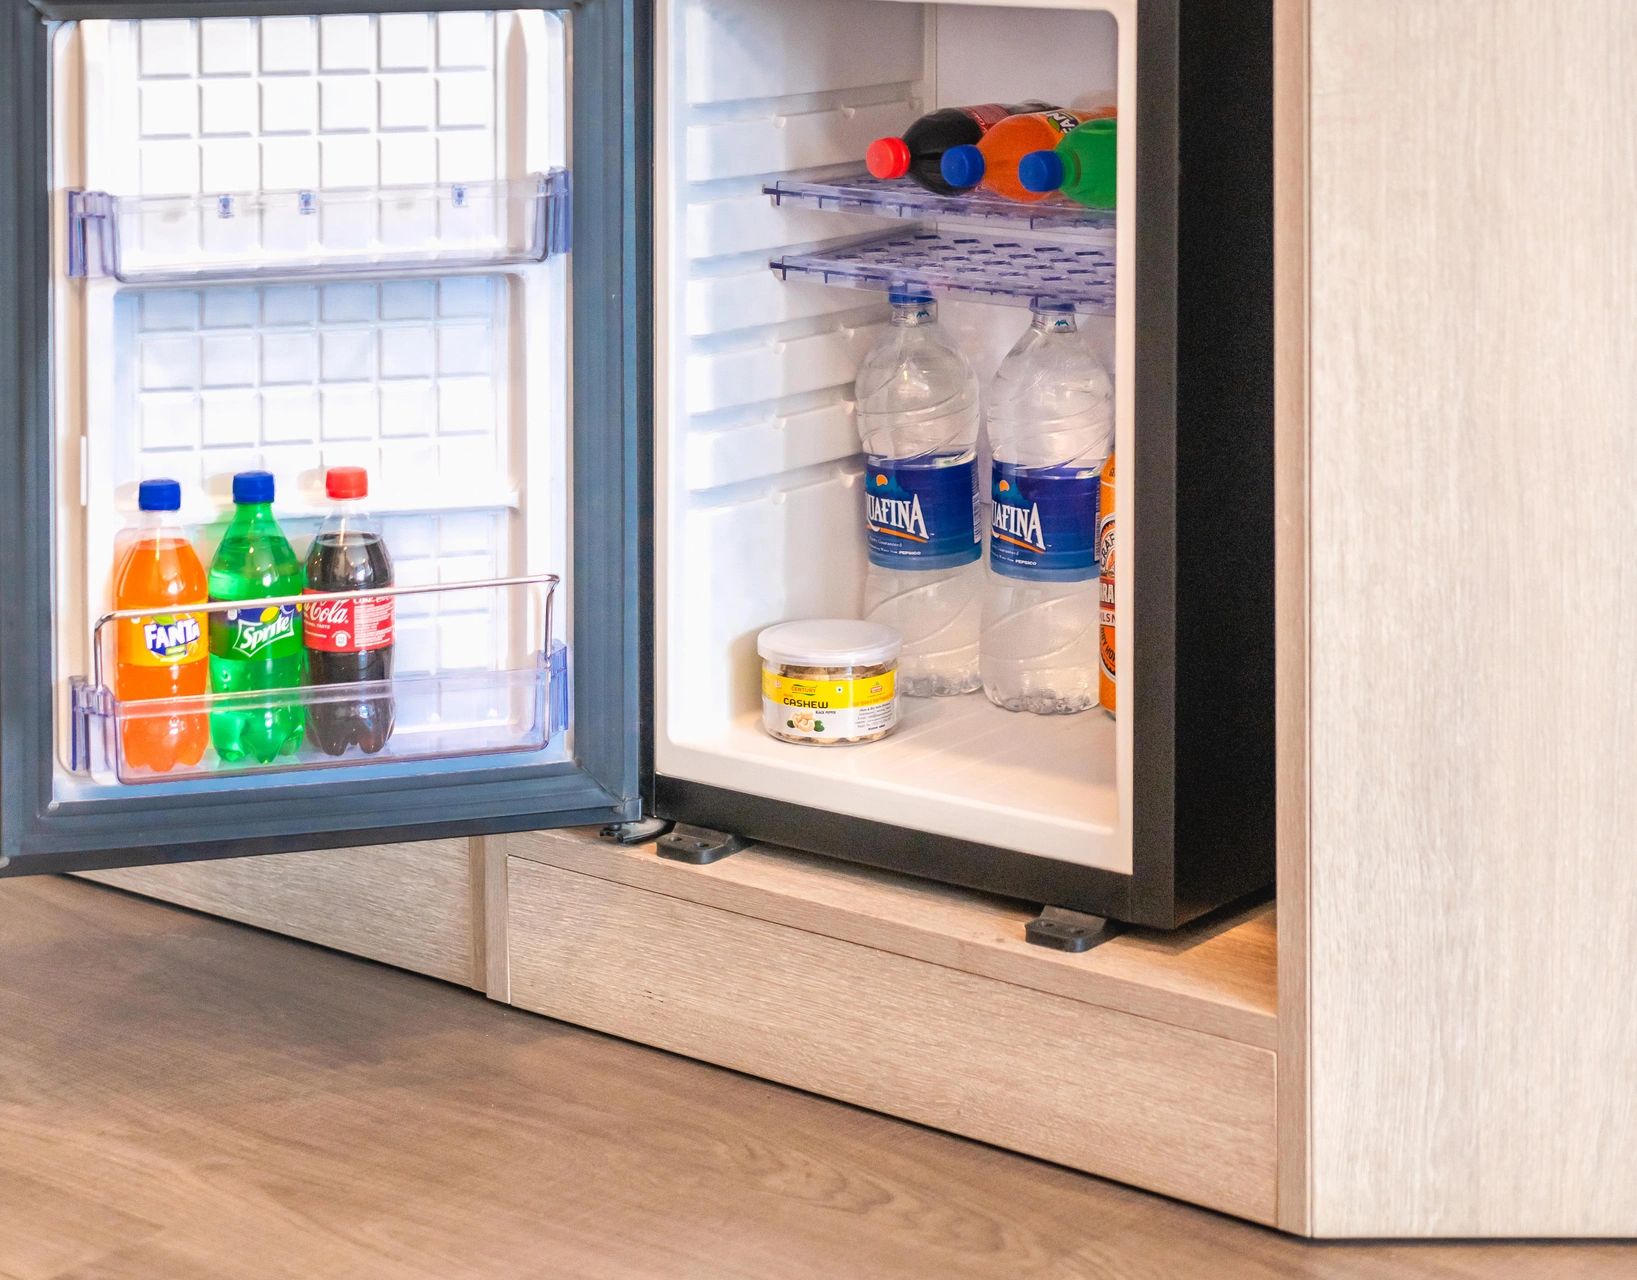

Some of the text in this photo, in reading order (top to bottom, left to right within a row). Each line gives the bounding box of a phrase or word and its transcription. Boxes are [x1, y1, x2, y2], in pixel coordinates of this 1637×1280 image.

[866, 493, 930, 539] UAFINA
[143, 618, 200, 650] FANTA
[240, 614, 290, 651] Sprite
[783, 697, 829, 709] CASHEW
